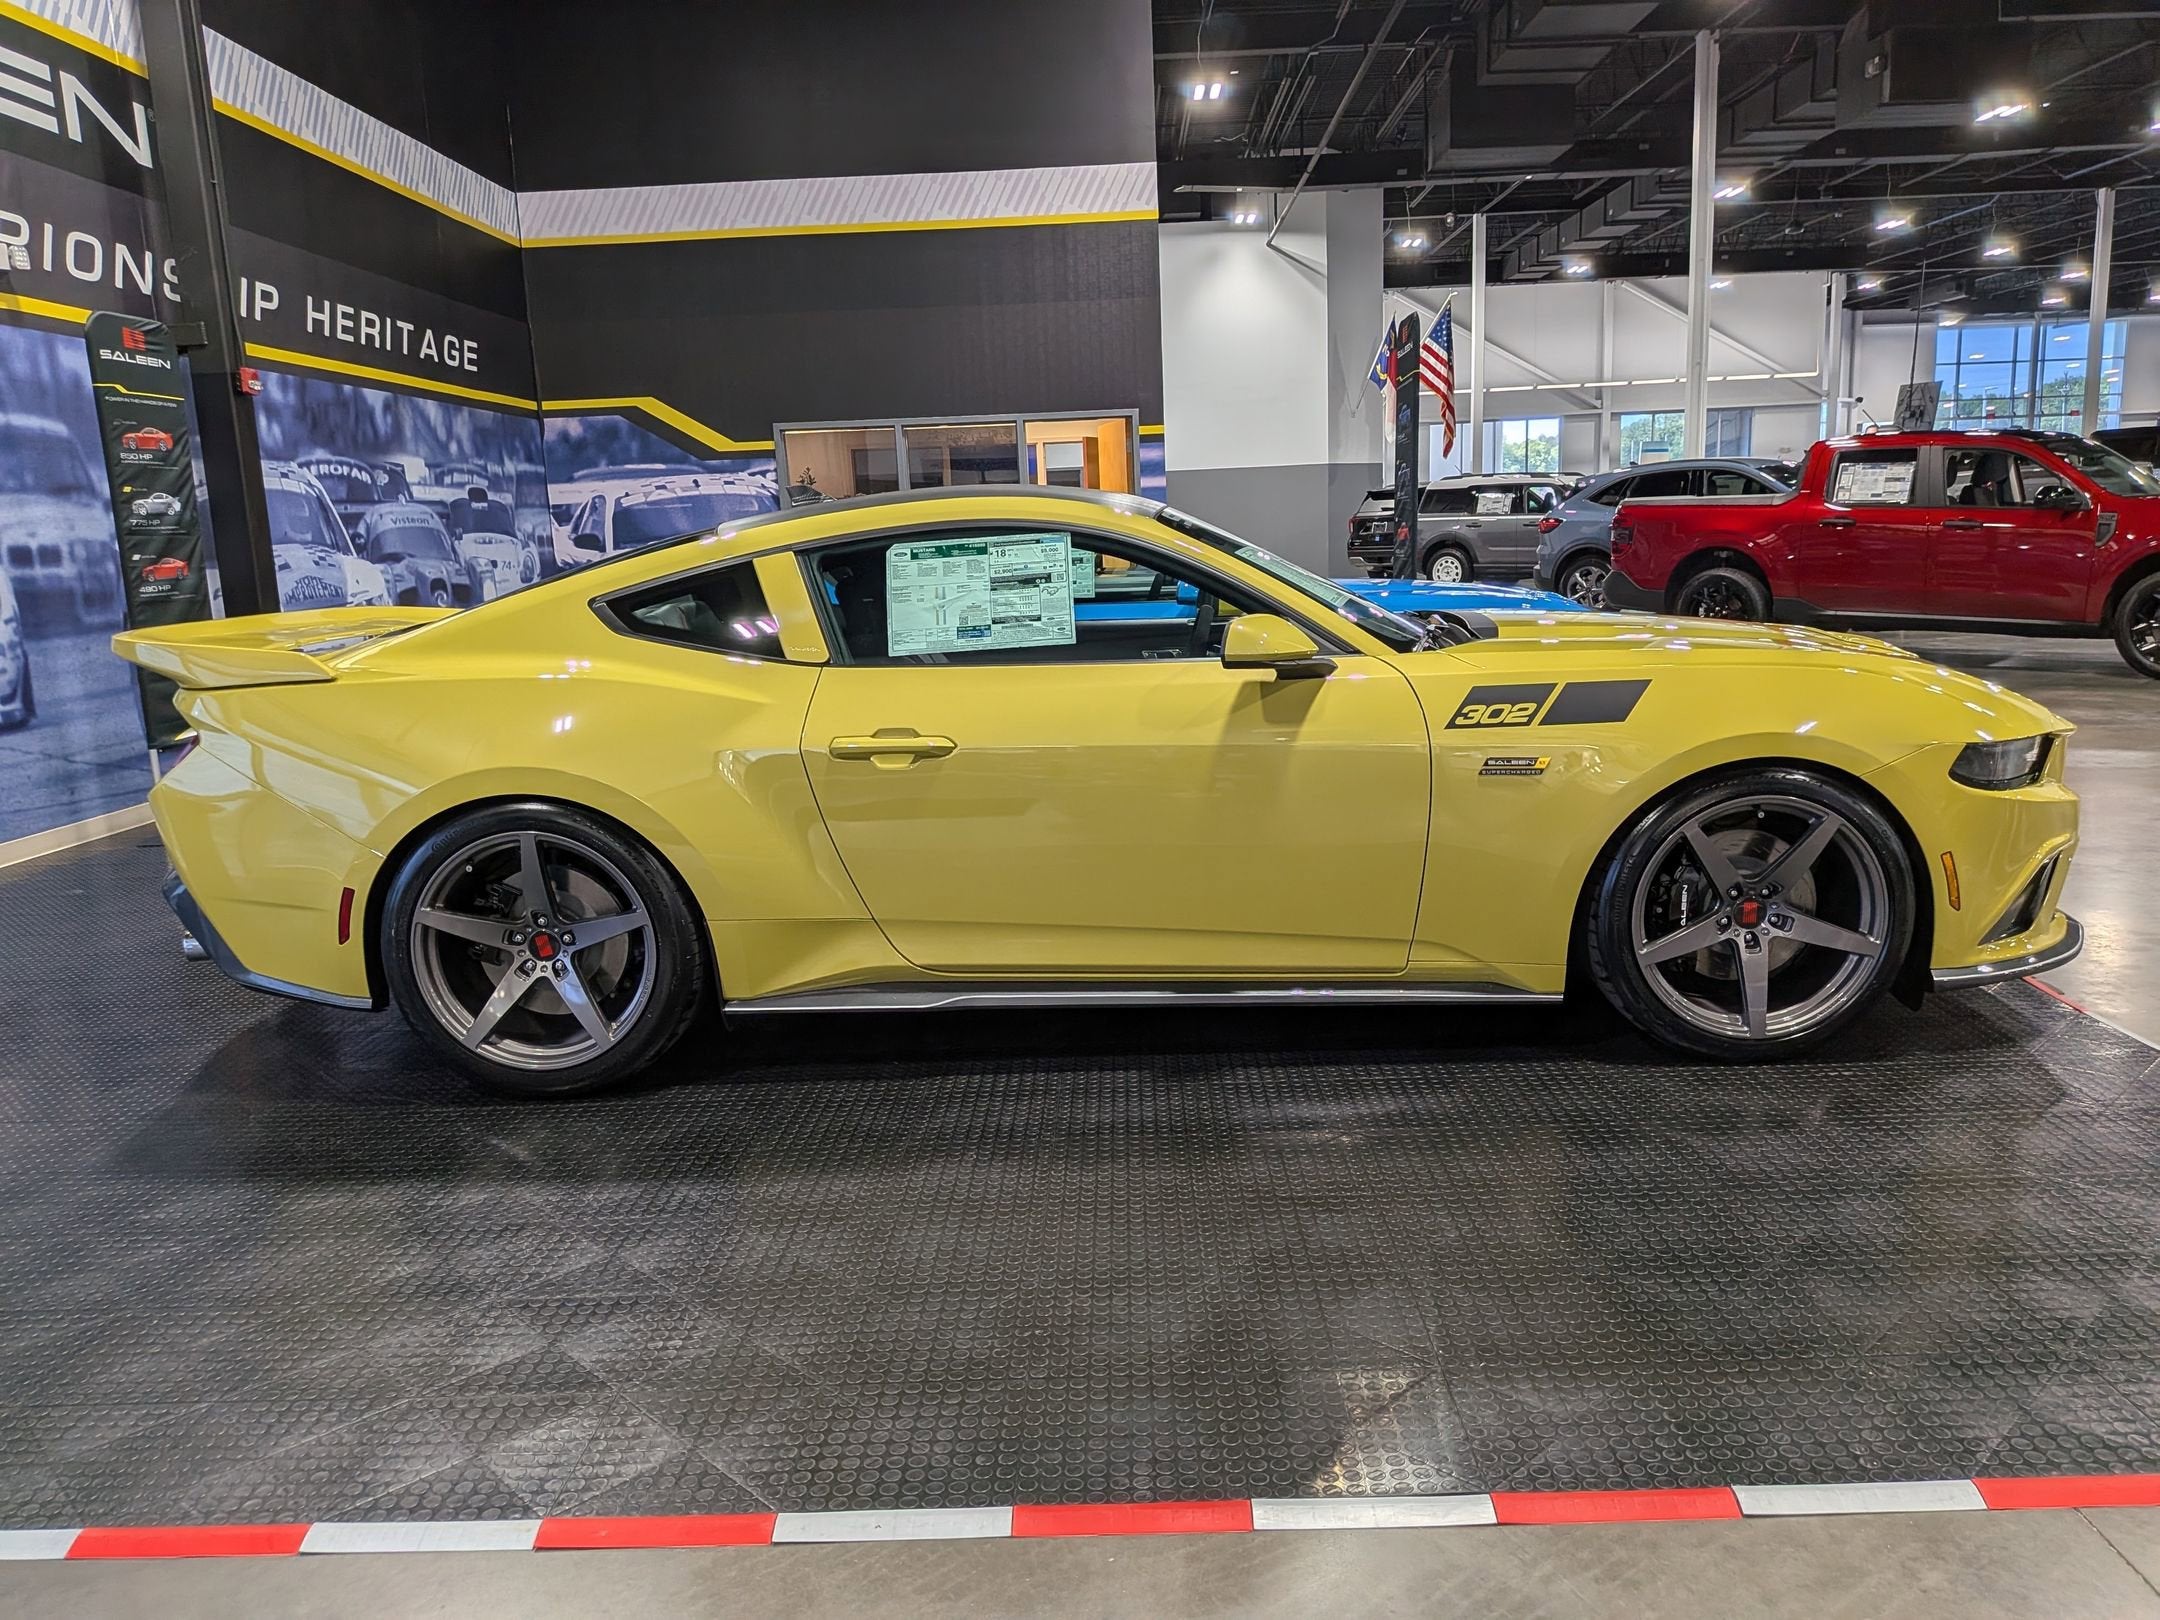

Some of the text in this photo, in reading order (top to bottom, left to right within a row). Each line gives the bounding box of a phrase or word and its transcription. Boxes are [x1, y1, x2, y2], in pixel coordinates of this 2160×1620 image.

[306, 295, 478, 372] HERITAGE
[99, 349, 171, 370] SALEEN
[391, 517, 430, 526] Visteon
[995, 549, 1007, 558] 18
[501, 561, 512, 571] 74
[294, 575, 324, 588] HOME
[284, 582, 344, 605] IMPROVEMENT
[1455, 702, 1538, 725] 302
[1680, 884, 1688, 926] ALEEN
